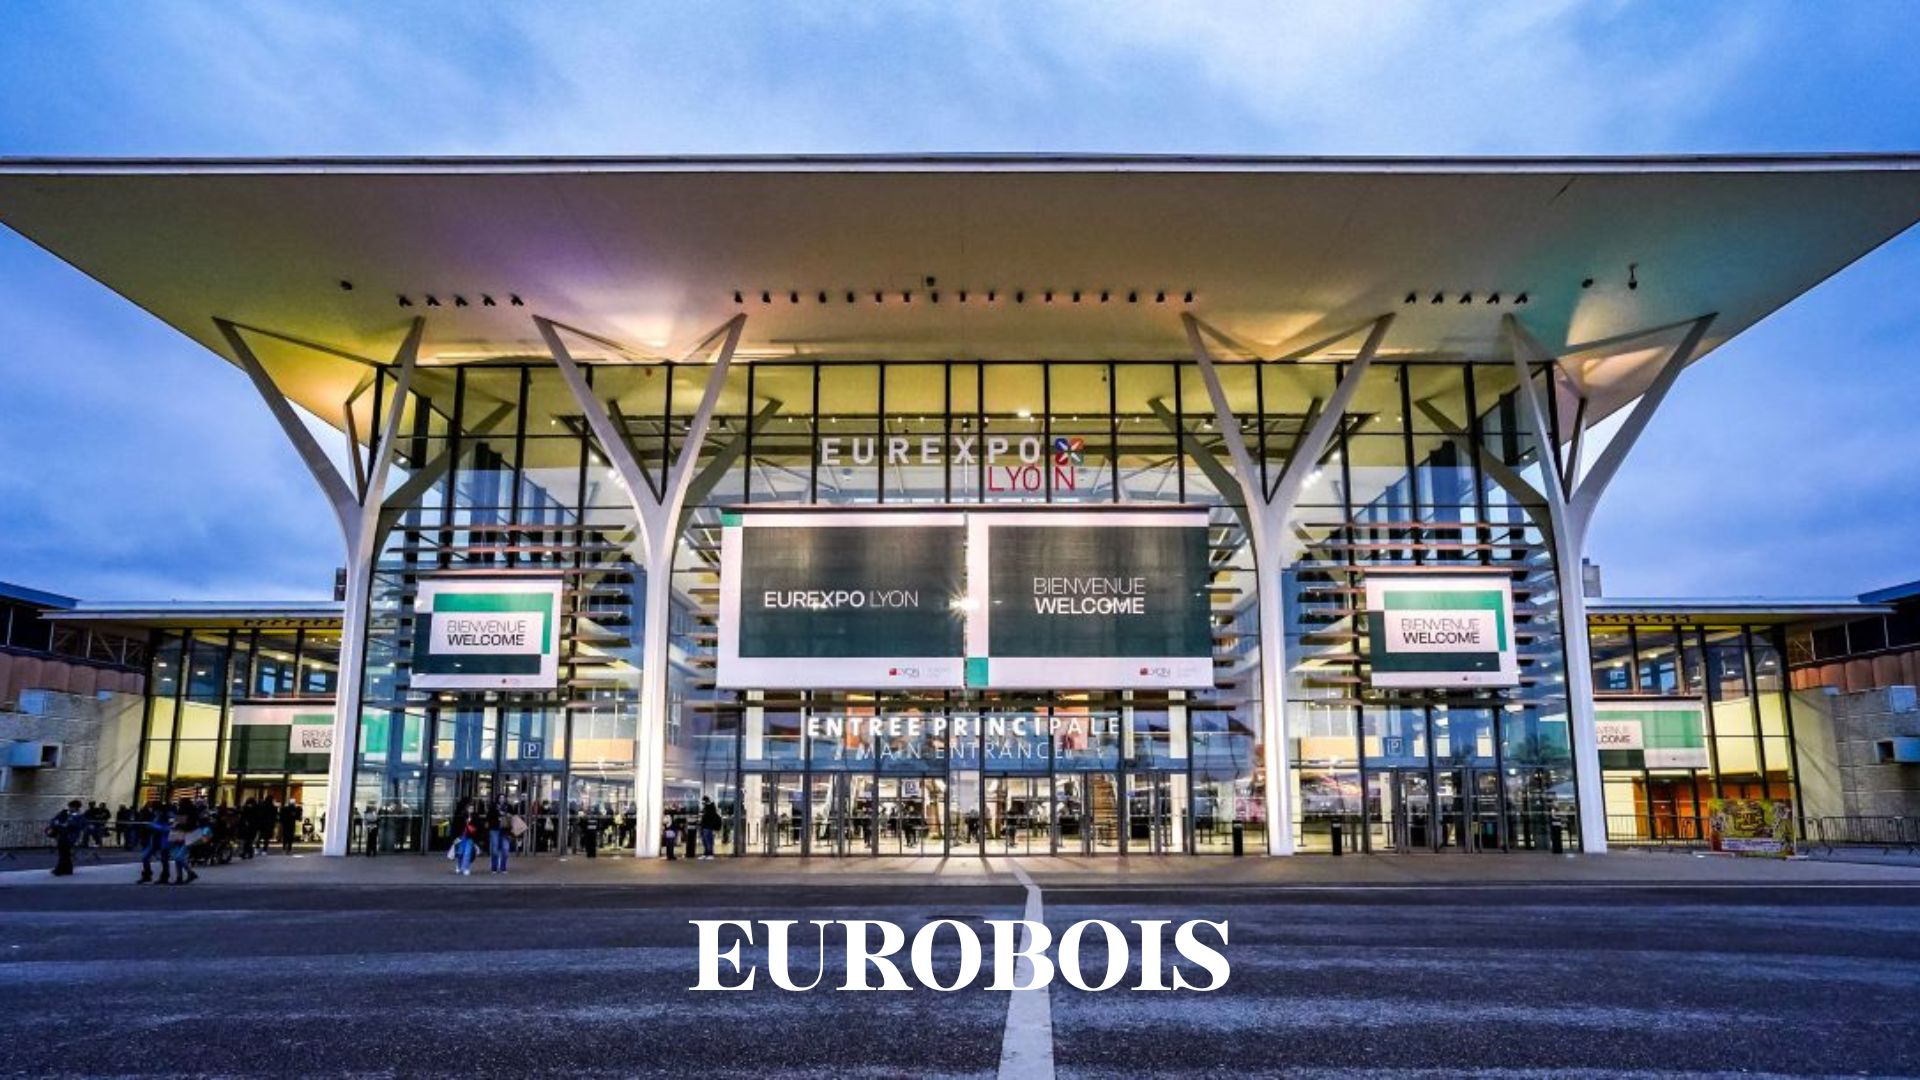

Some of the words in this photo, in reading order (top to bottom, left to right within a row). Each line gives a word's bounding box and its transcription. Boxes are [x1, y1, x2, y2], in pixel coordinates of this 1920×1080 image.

[821, 437, 1040, 465] EUREXPO
[988, 465, 1075, 491] LYON
[1033, 577, 1146, 595] BIENVENUE
[764, 590, 865, 608] EUREXPO
[869, 590, 919, 608] LYON
[1034, 597, 1145, 614] WELCOME
[446, 619, 527, 633] BIENVENUE
[1401, 618, 1480, 632] BIENVENUE
[447, 633, 525, 646] WELCOME
[1403, 632, 1480, 645] WELCOME
[807, 716, 921, 737] ENTREE
[933, 716, 1121, 737] PRINCIPALE
[301, 738, 332, 748] WELC
[1596, 734, 1631, 744] LCOME
[935, 741, 1064, 759] ENTRANCE
